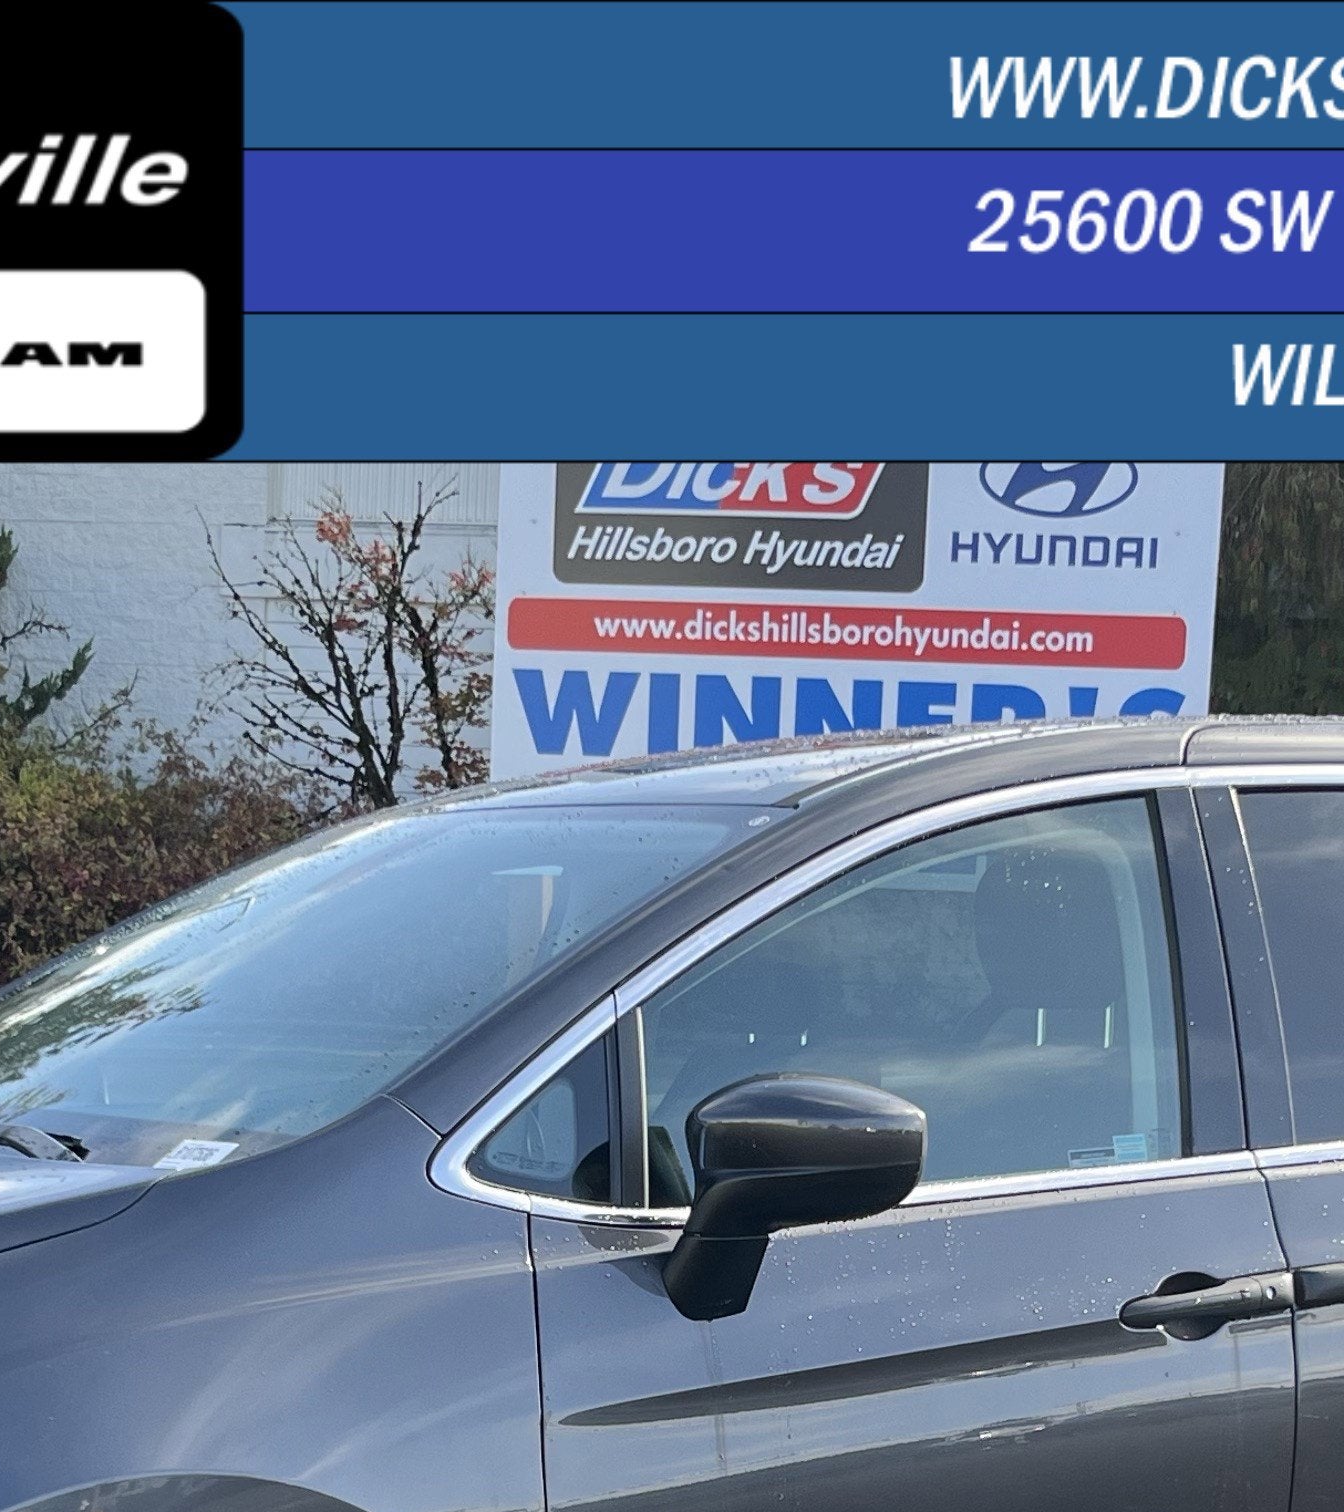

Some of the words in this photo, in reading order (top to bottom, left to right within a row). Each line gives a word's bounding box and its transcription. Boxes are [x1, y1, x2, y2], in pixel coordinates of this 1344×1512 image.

[567, 525, 738, 564] Hillsboro
[742, 530, 905, 574] Hyundai
[951, 531, 1158, 570] HYUNDAI
[593, 610, 1094, 656] www.dickshillsborohyundai.com
